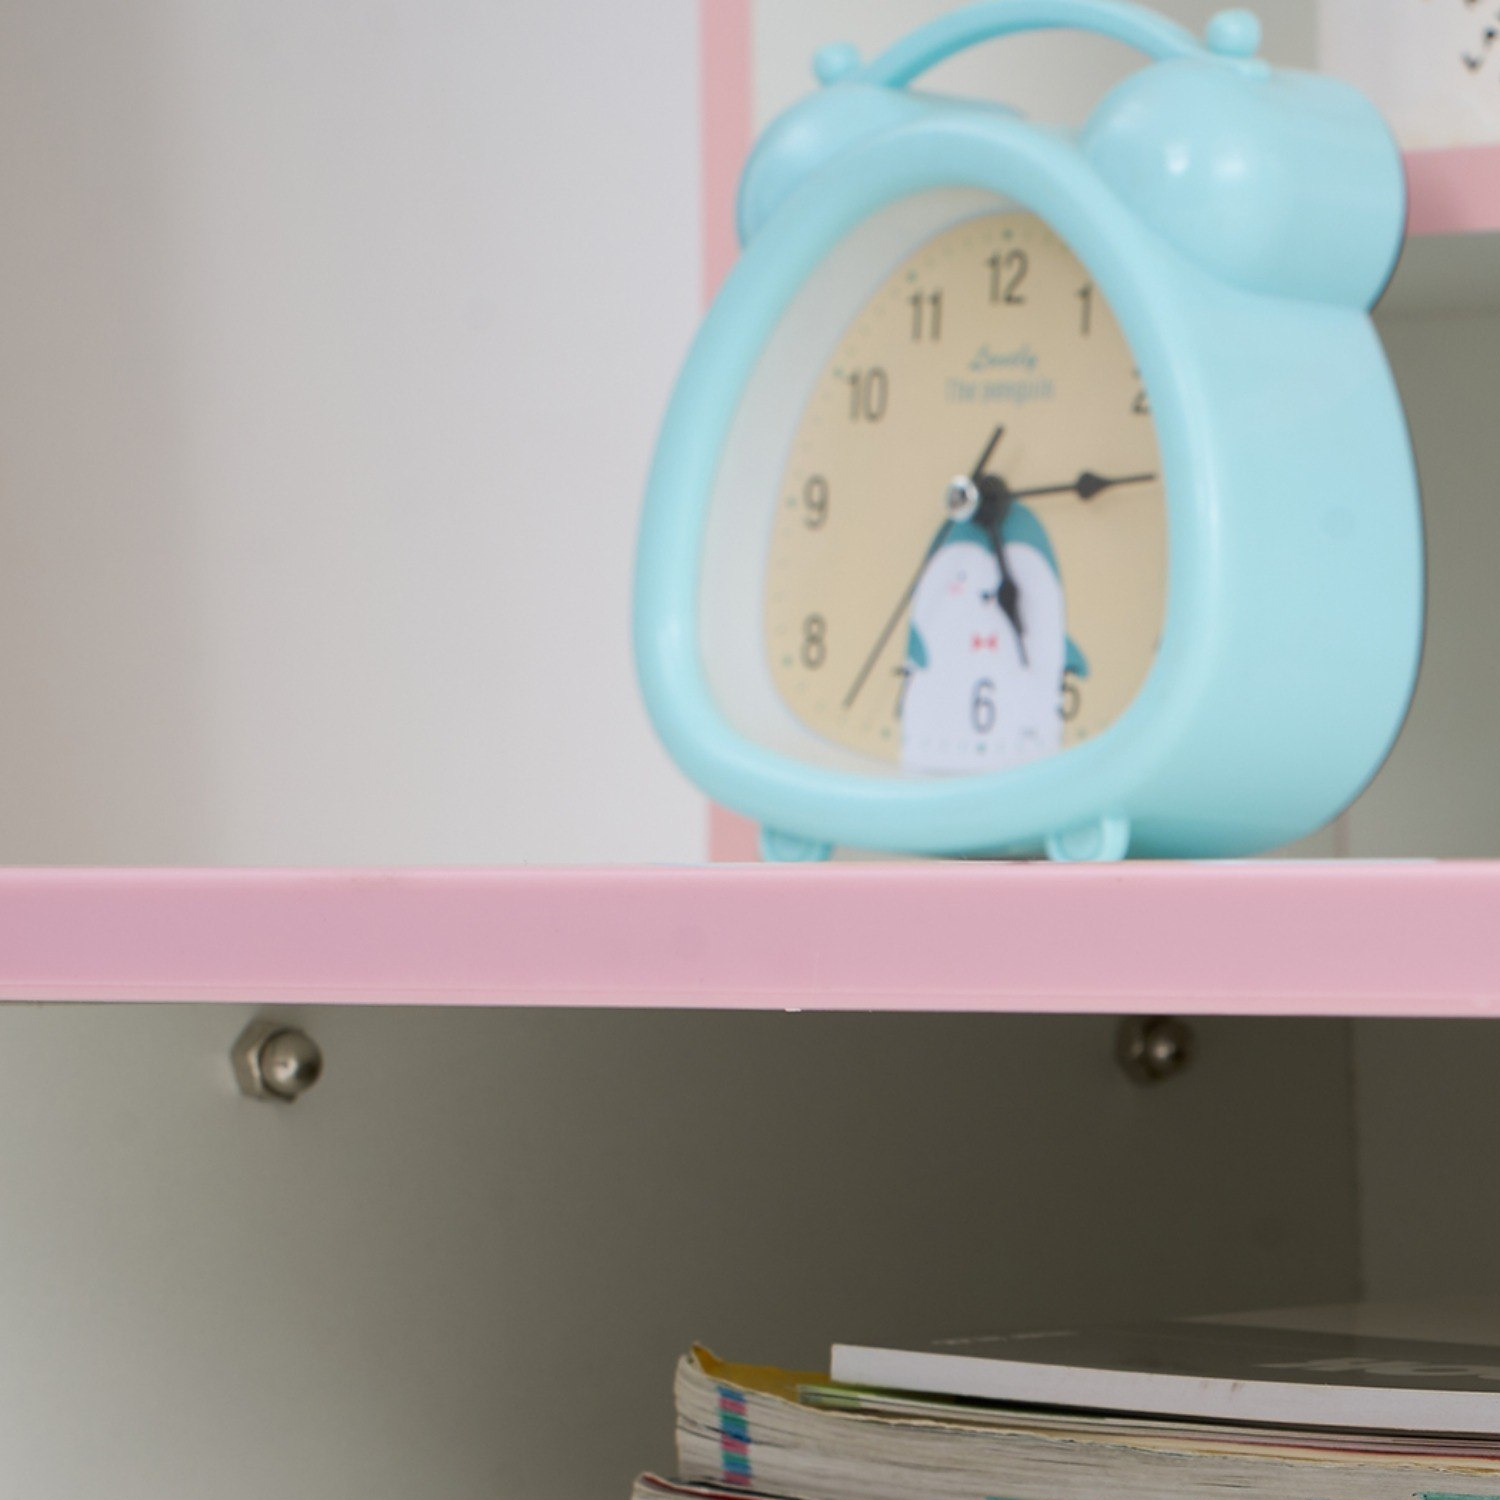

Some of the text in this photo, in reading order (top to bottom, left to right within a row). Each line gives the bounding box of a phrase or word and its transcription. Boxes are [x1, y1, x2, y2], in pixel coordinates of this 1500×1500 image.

[988, 248, 1028, 305] 12
[908, 289, 942, 342] 11
[1073, 282, 1092, 337] 1
[847, 367, 889, 423] 10
[803, 474, 829, 530] 9
[802, 613, 827, 670] 8
[970, 676, 996, 735] 6
